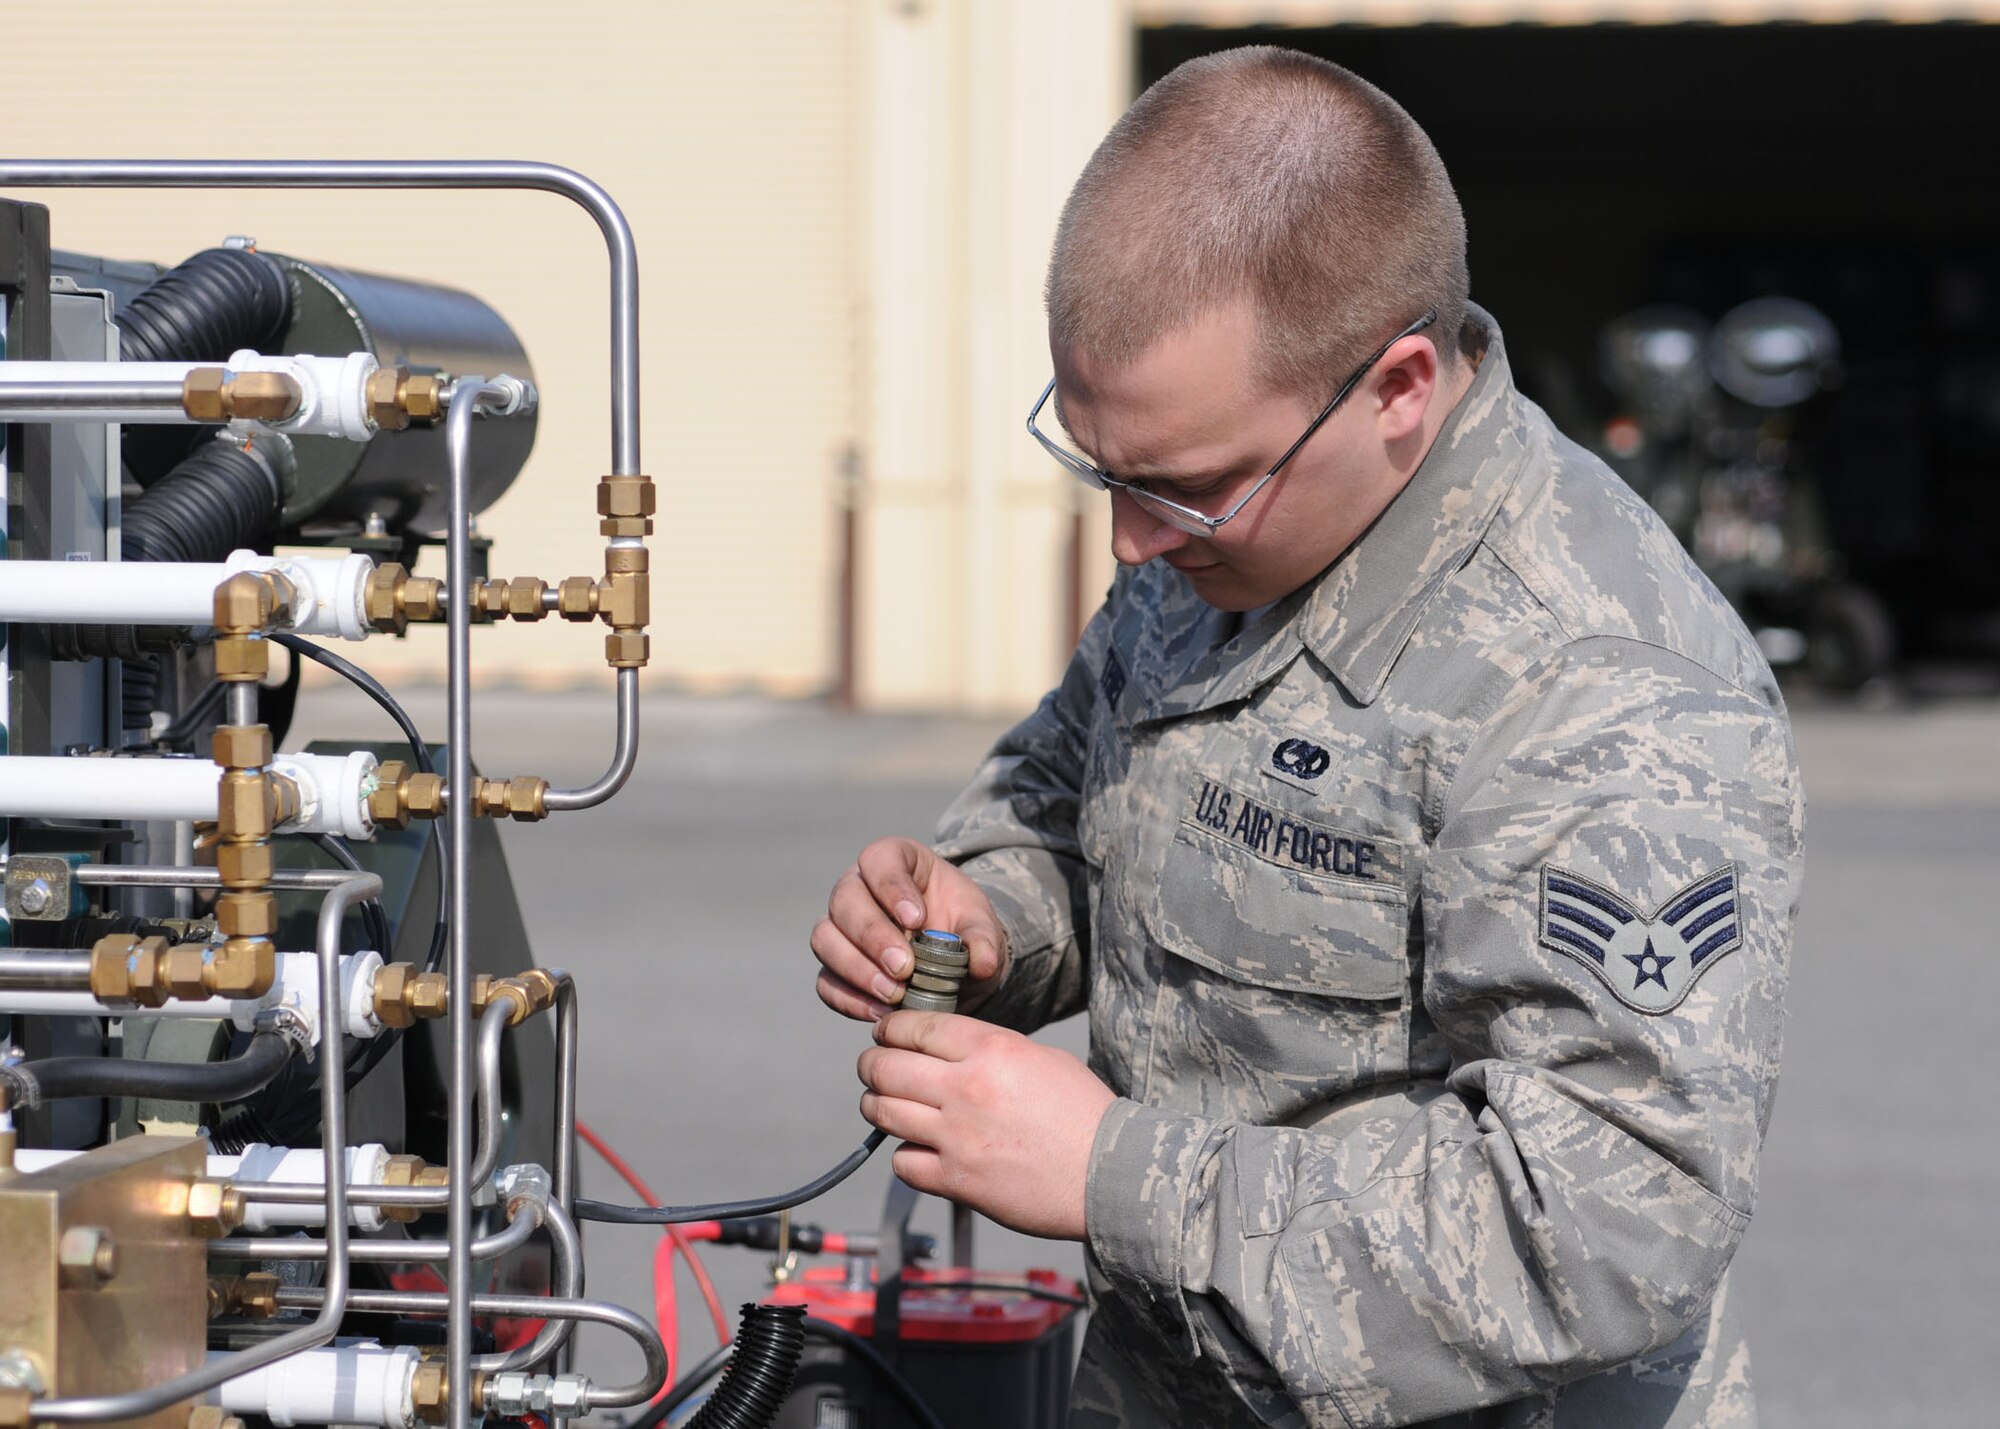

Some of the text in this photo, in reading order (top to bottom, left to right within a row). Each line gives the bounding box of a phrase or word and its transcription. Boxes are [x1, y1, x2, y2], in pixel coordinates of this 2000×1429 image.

[1196, 781, 1376, 879] U.S. AIR FORCE
